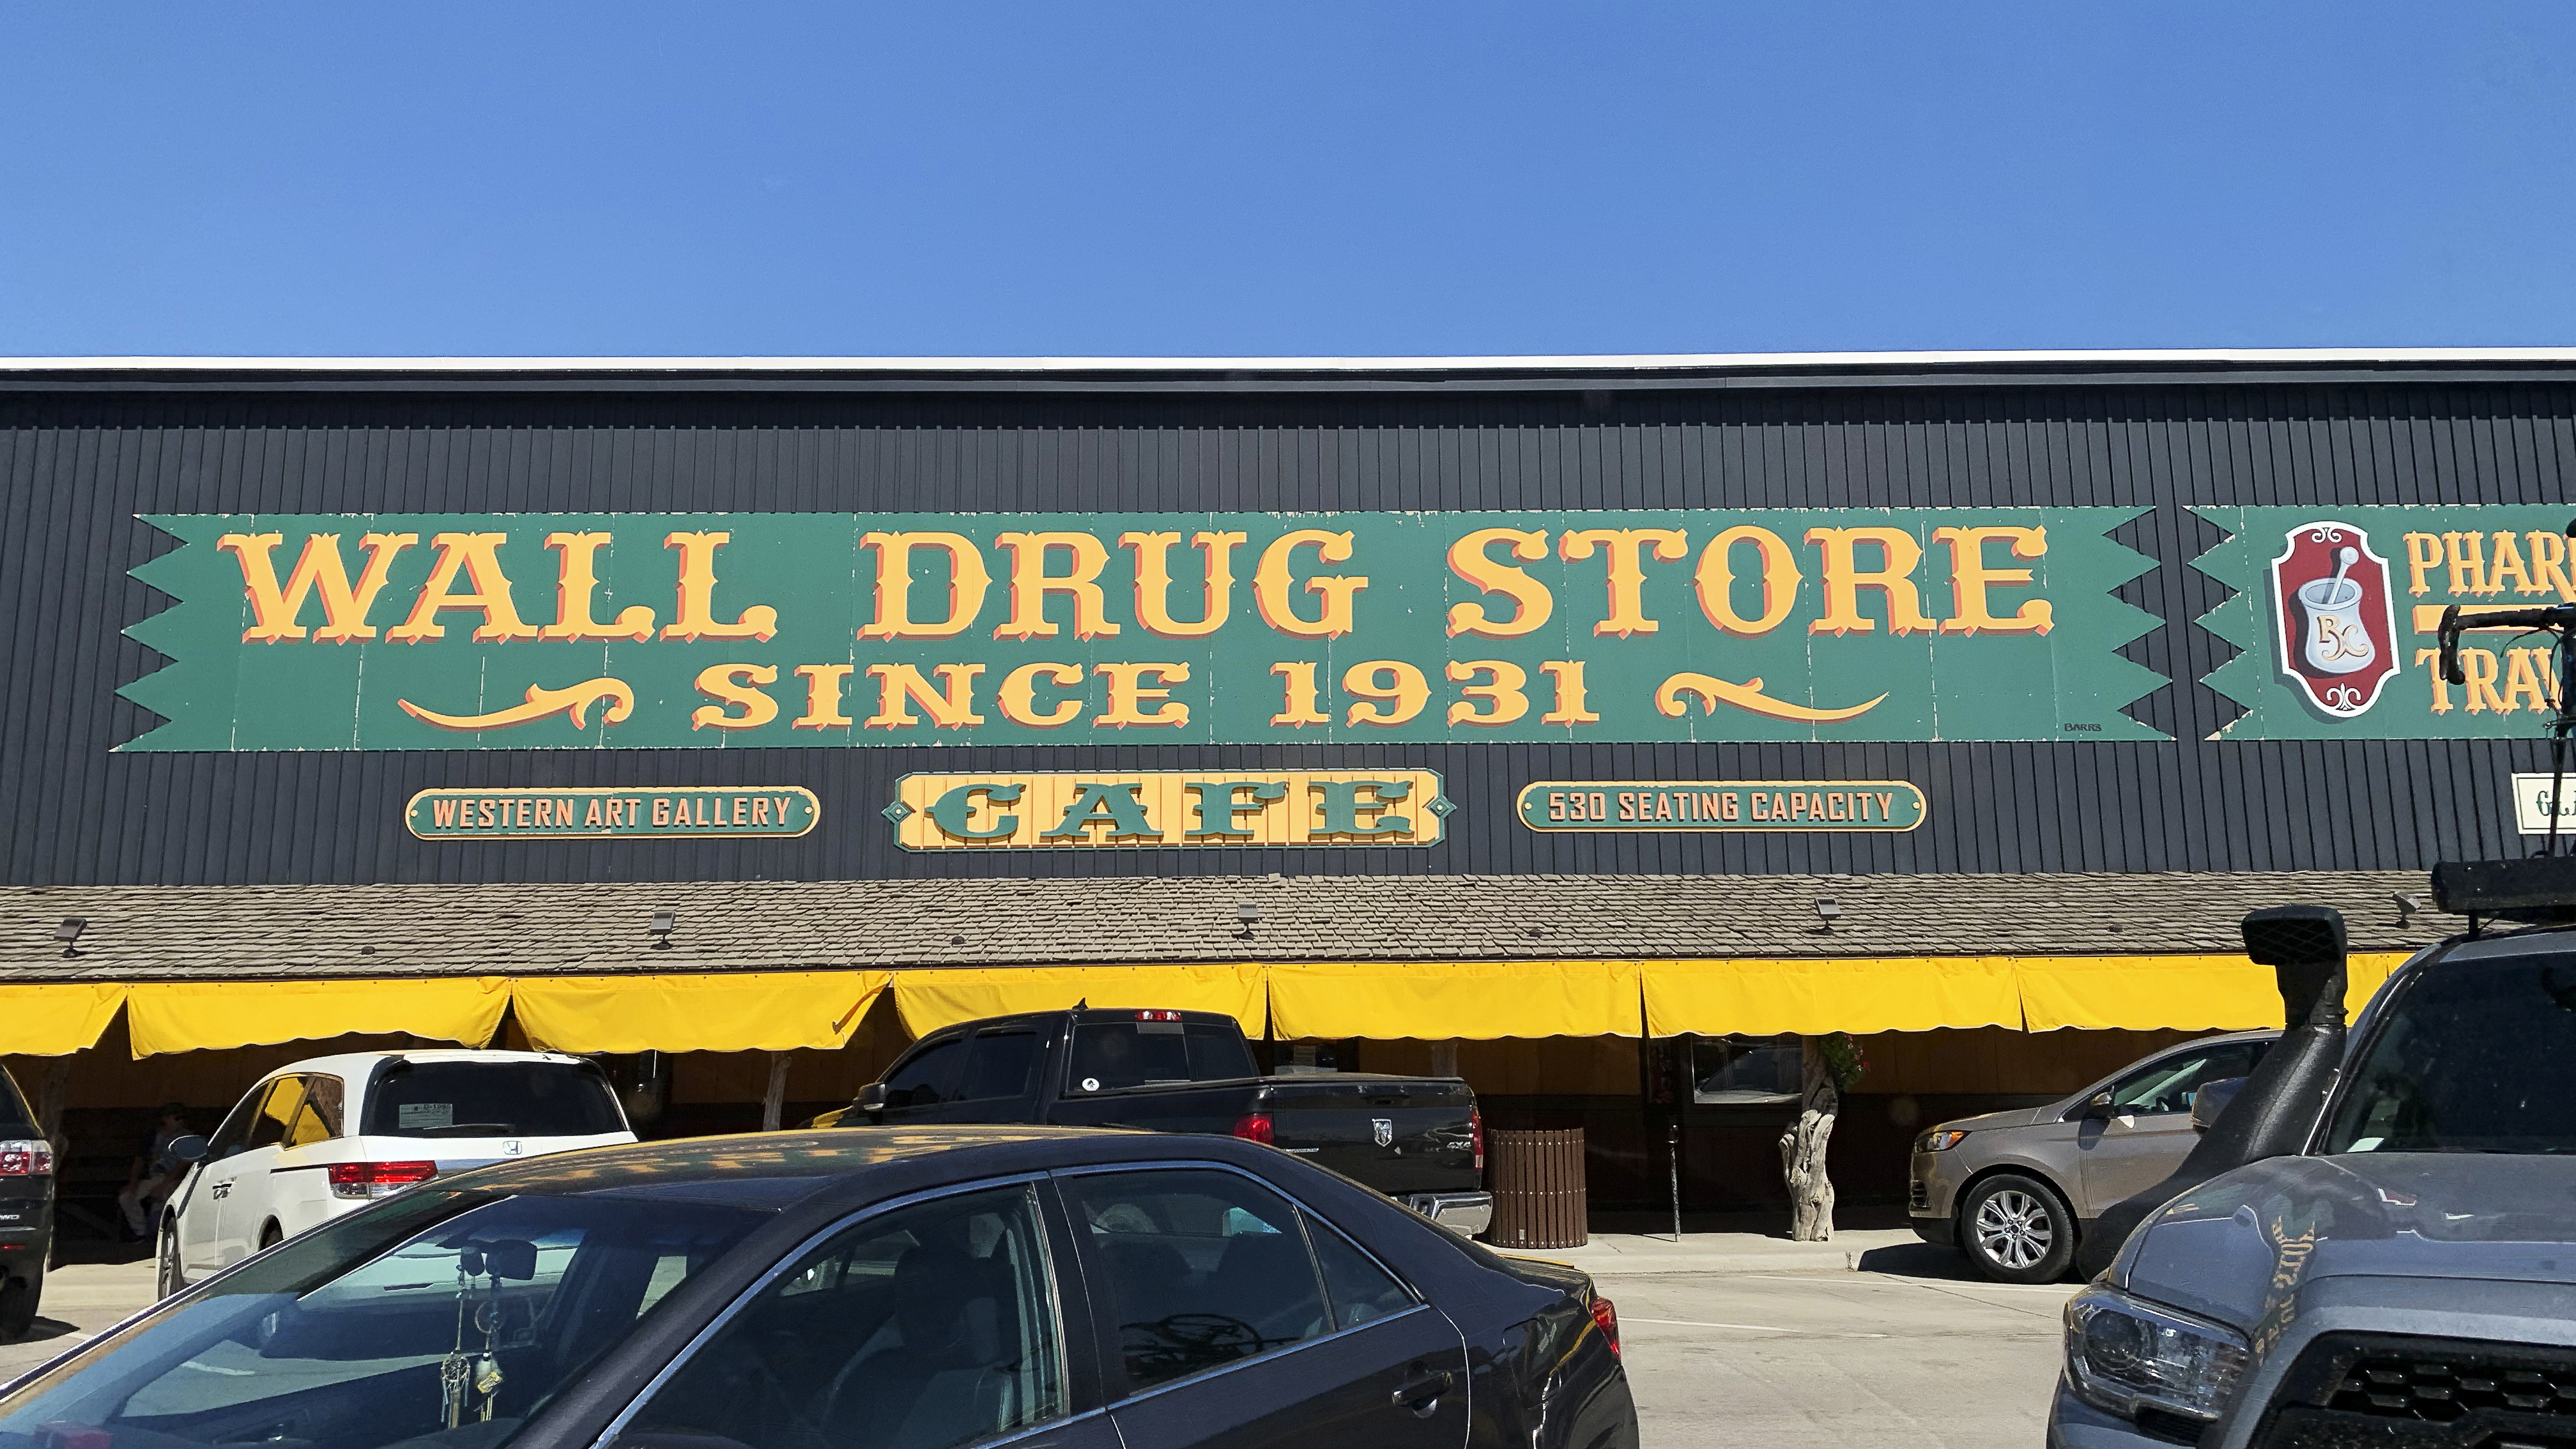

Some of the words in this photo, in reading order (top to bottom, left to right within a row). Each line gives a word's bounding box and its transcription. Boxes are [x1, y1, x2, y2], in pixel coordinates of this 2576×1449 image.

[216, 531, 777, 645] WALL
[856, 529, 1369, 643] DRUG
[1445, 525, 2055, 640] STORE
[690, 662, 1190, 732] SINCE
[1269, 659, 1600, 728] 1931
[433, 799, 574, 827] WESTERN
[585, 798, 641, 827] ART
[652, 797, 791, 826] GALLERY
[924, 781, 1416, 841] CAFE
[1549, 792, 1606, 821] 530
[1618, 792, 1738, 821] SEATING
[1751, 792, 1893, 820] CAPACITY
